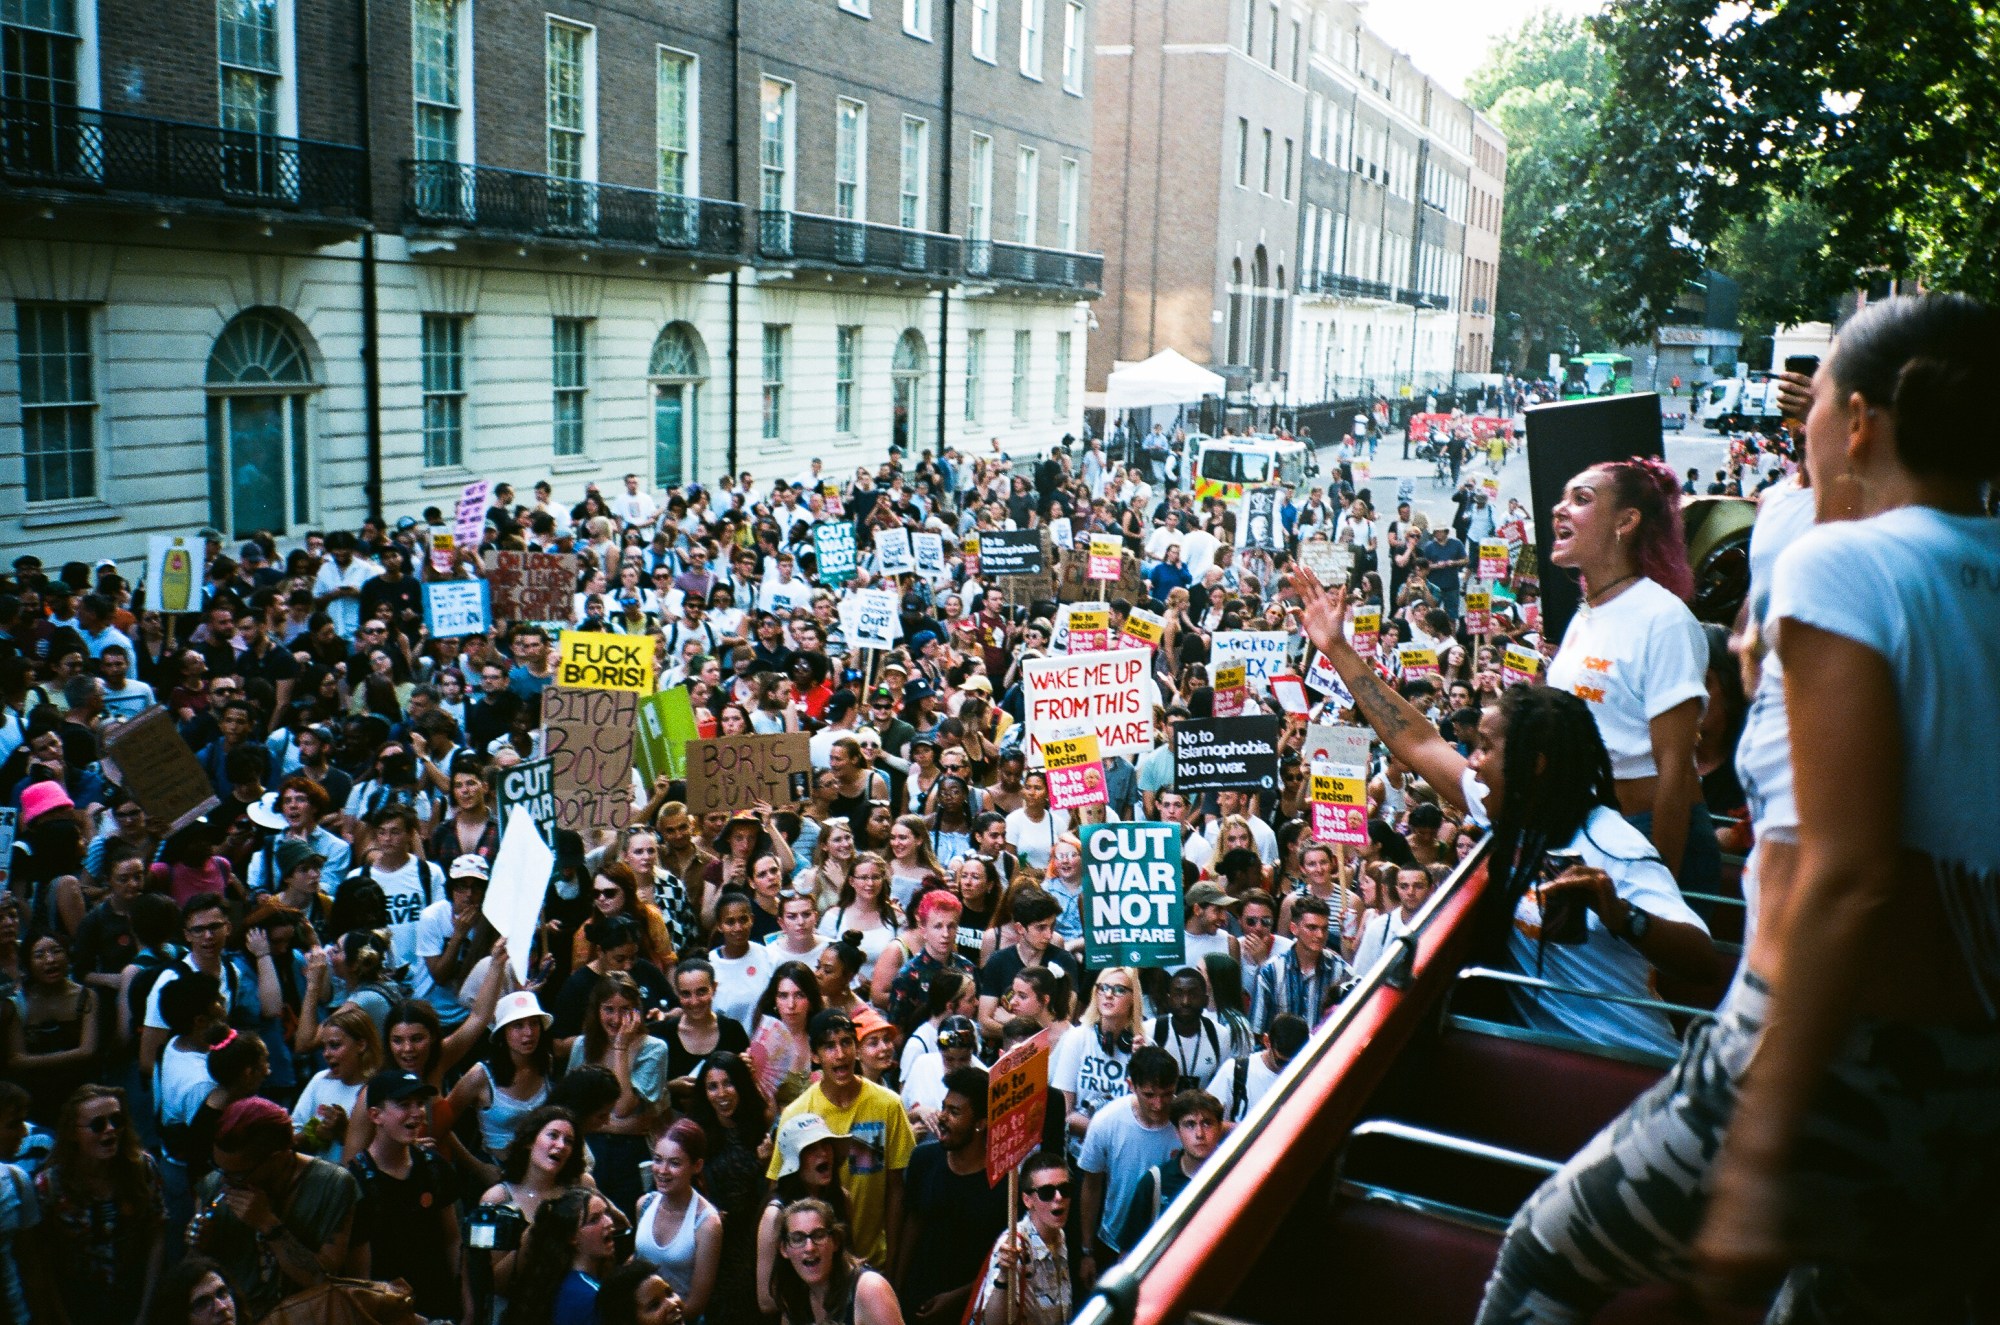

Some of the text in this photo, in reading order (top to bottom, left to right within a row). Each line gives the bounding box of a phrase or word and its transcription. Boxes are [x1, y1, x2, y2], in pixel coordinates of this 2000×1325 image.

[817, 523, 853, 539] CUT
[818, 537, 855, 552] WAR
[821, 550, 855, 566] NOT
[861, 614, 889, 627] Out!
[572, 643, 641, 665] FUCK
[564, 664, 646, 687] BORIS!
[1029, 659, 1142, 690] WAKE ME UP
[543, 687, 637, 727] BITCH
[1034, 689, 1139, 721] FROM THIS
[1030, 720, 1150, 756] NMARE
[1177, 730, 1214, 745] No to
[546, 726, 634, 790] BOY
[703, 741, 791, 777] BORIS
[1046, 742, 1076, 756] No to
[1178, 740, 1274, 759] Islamophobia.
[1048, 754, 1087, 767] racism
[1178, 762, 1247, 777] No to war.
[504, 763, 551, 800] CUT
[1050, 770, 1082, 784] No to
[1315, 777, 1344, 790] No to
[1052, 782, 1084, 796] Boris
[1315, 791, 1353, 802] racism
[1055, 791, 1104, 808] Johnson
[1315, 804, 1346, 818] No to
[1316, 817, 1346, 830] Boris
[1089, 828, 1172, 861] CUT
[1316, 828, 1364, 843] Johnson
[1088, 862, 1176, 893] WAR
[1092, 894, 1176, 927] NOT
[1093, 928, 1176, 944] WELFARE
[1081, 1055, 1126, 1080] STO
[992, 1072, 1025, 1101] No to
[1080, 1075, 1127, 1096] TRUM
[992, 1083, 1034, 1121] racism
[992, 1114, 1025, 1145] No to
[991, 1130, 1025, 1162] Boris
